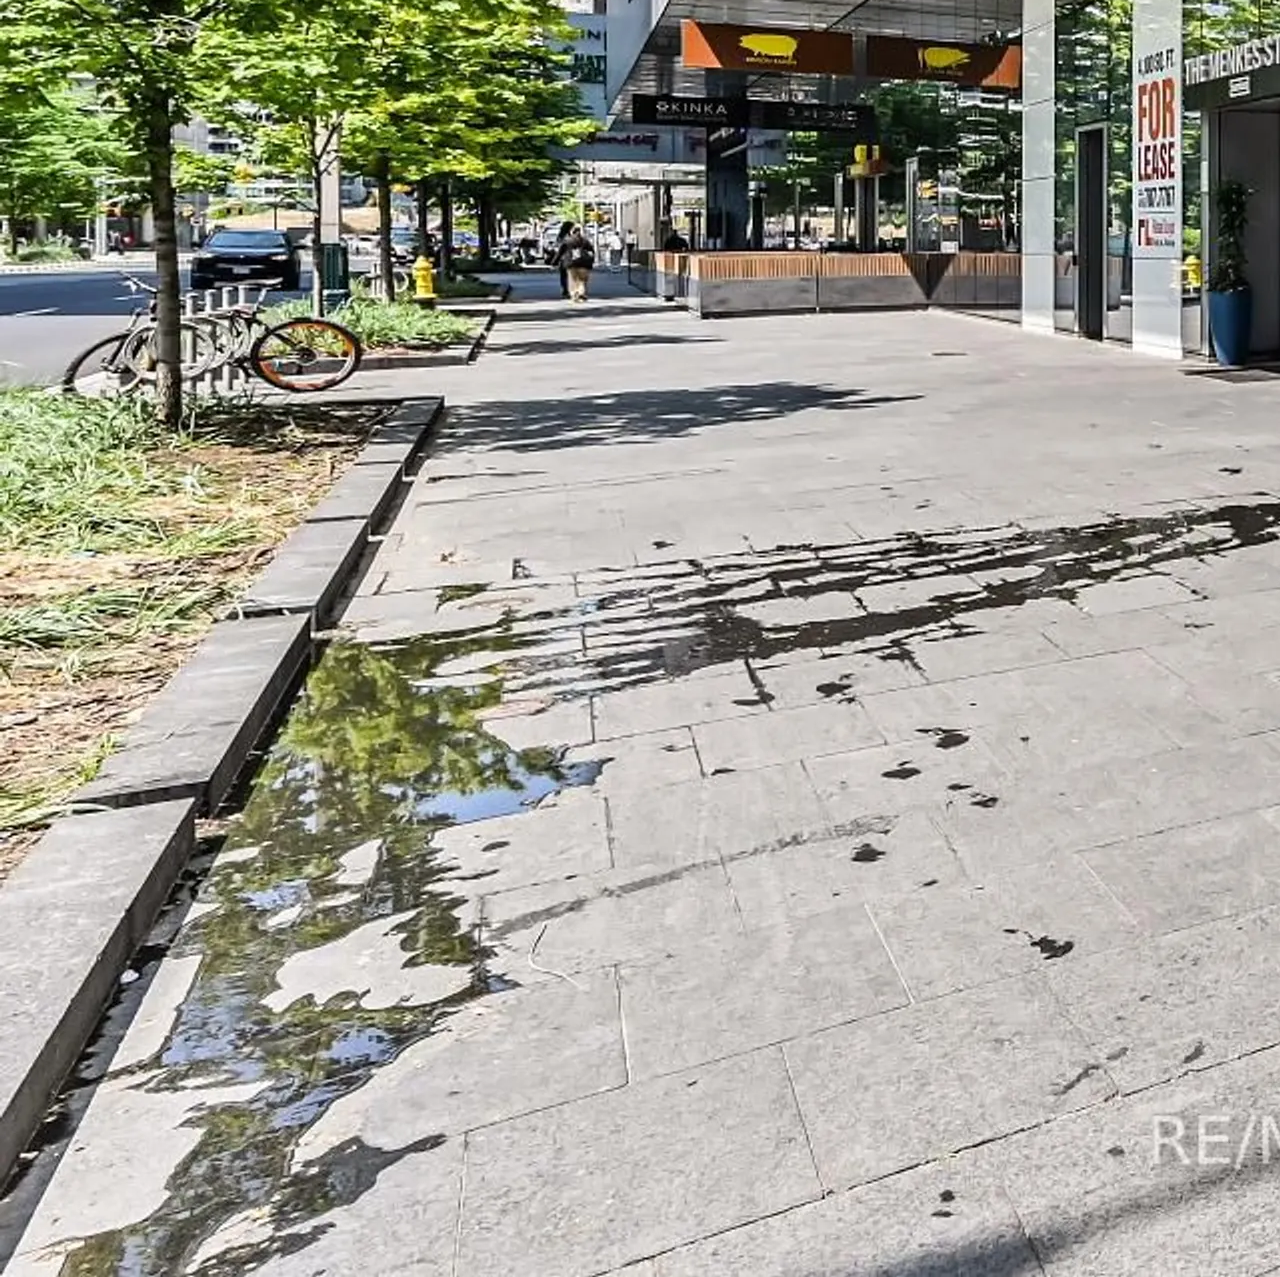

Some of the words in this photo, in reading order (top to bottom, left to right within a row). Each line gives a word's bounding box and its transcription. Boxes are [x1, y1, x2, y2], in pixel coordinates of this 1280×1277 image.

[1184, 54, 1208, 86] THE
[1208, 38, 1262, 80] MENKES
[671, 102, 728, 115] KINKA
[1138, 78, 1175, 142] FOR
[1138, 142, 1175, 182] LEASE
